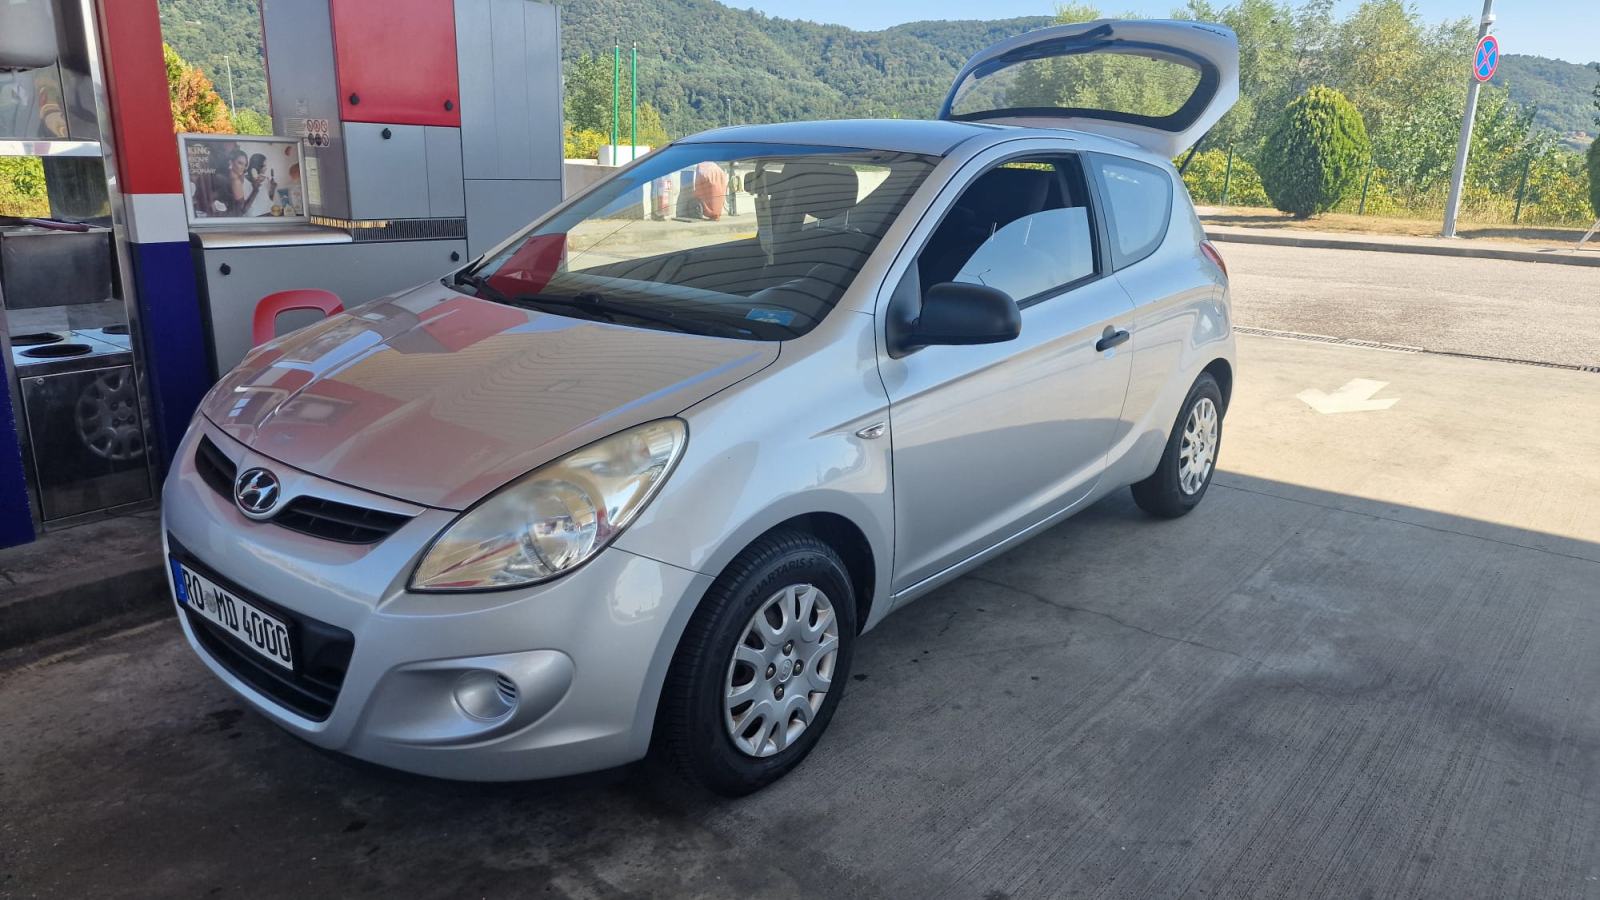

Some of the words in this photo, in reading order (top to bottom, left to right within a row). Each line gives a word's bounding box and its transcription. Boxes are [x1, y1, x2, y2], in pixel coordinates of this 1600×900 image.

[182, 568, 205, 611] RO
[213, 587, 240, 632] MD
[242, 605, 292, 663] 4000
